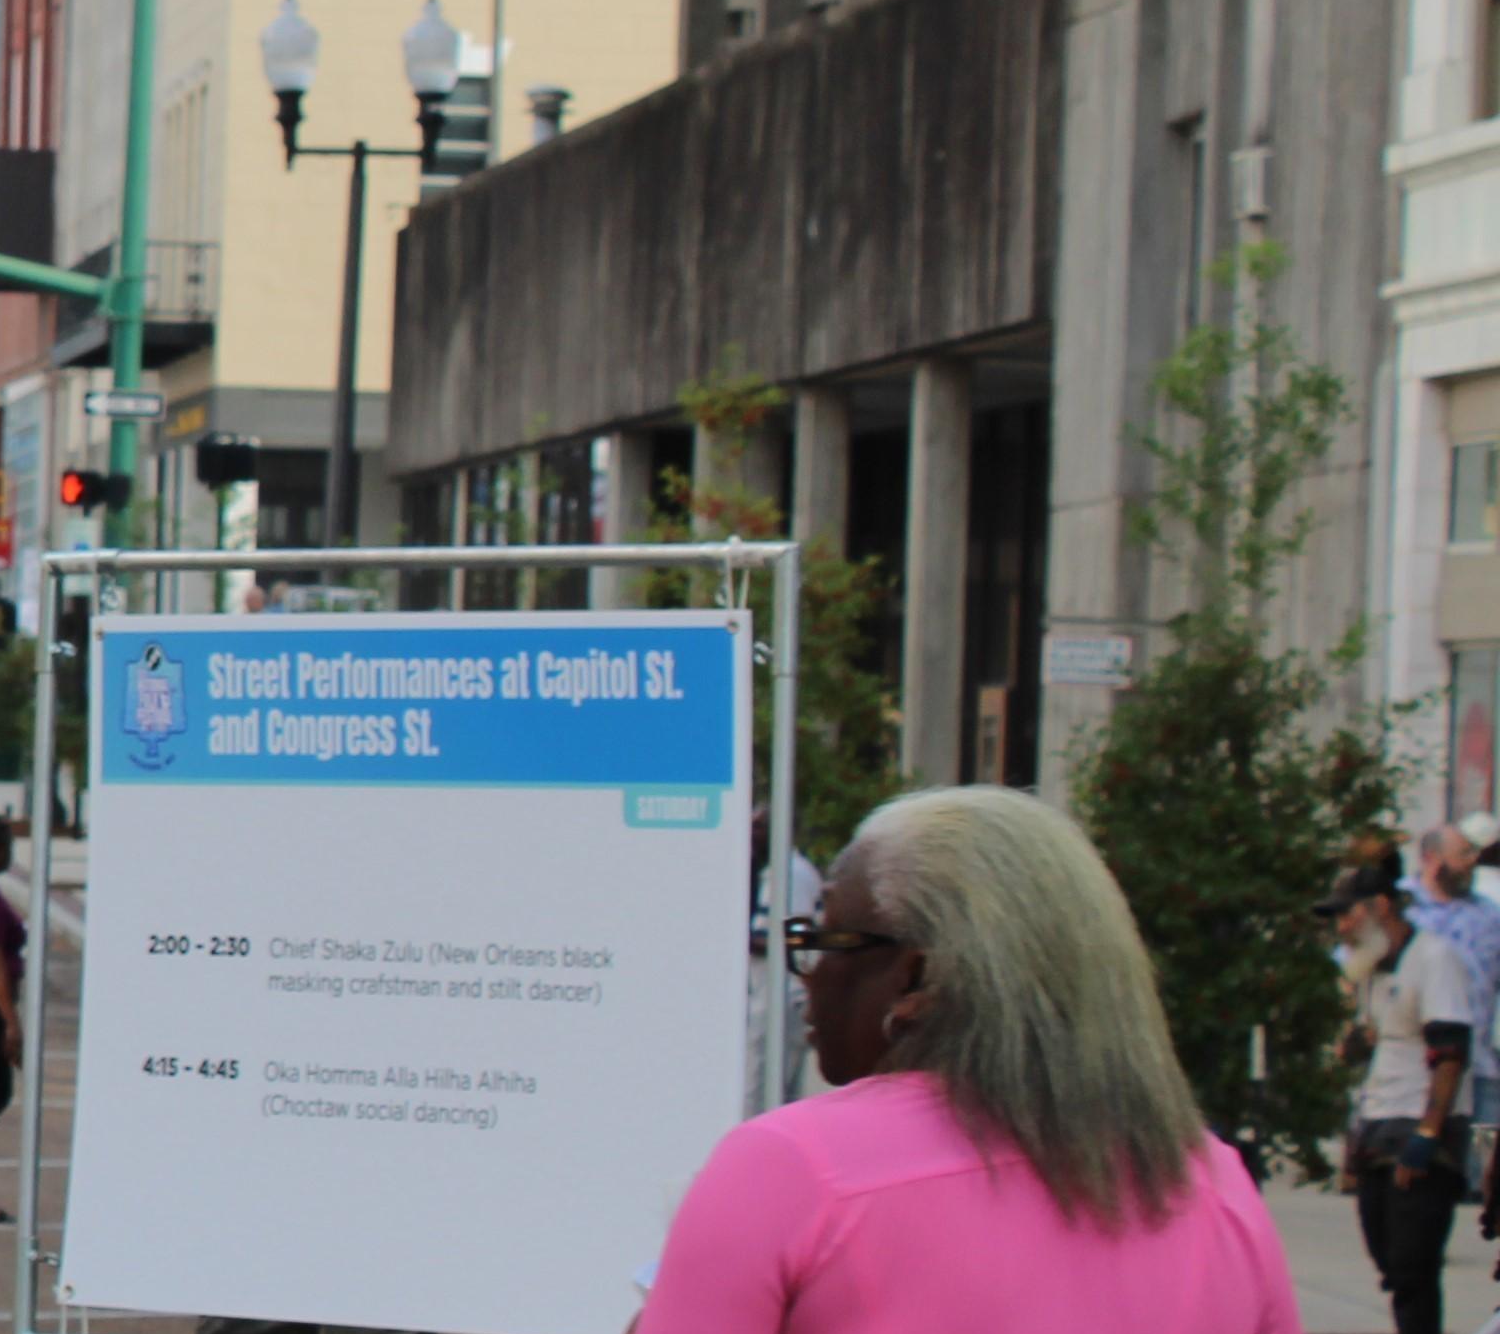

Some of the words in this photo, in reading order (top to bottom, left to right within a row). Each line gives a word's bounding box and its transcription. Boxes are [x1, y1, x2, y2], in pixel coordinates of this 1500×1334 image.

[208, 652, 290, 700] Street
[297, 652, 494, 700] Performances
[501, 653, 531, 700] at
[537, 649, 639, 707] Capitol
[644, 651, 684, 700] St.
[208, 708, 259, 756] and
[266, 709, 397, 762] Congress
[403, 709, 440, 757] St.
[636, 795, 708, 822] SATURDAY
[148, 935, 191, 957] 2:00
[210, 936, 251, 958] 2:30
[269, 937, 318, 960] Chief
[322, 939, 377, 963] Shaka
[383, 941, 424, 964] Zulu
[429, 942, 480, 968] (New
[484, 944, 558, 969] Orleans
[562, 945, 614, 970] black
[268, 971, 344, 998] masking
[349, 973, 443, 998] crafstman
[447, 975, 483, 1000] and
[488, 977, 523, 1002] stilt
[528, 978, 603, 1005] dancer)
[143, 1056, 180, 1078] 4:15
[197, 1058, 240, 1081] 4:45
[263, 1062, 301, 1084] Oka
[305, 1064, 378, 1087] Homma
[383, 1066, 419, 1089] Alla
[425, 1069, 472, 1092] Hilha
[262, 1094, 351, 1121] (Choctaw
[356, 1097, 410, 1123] social
[414, 1100, 499, 1130] dancing)
